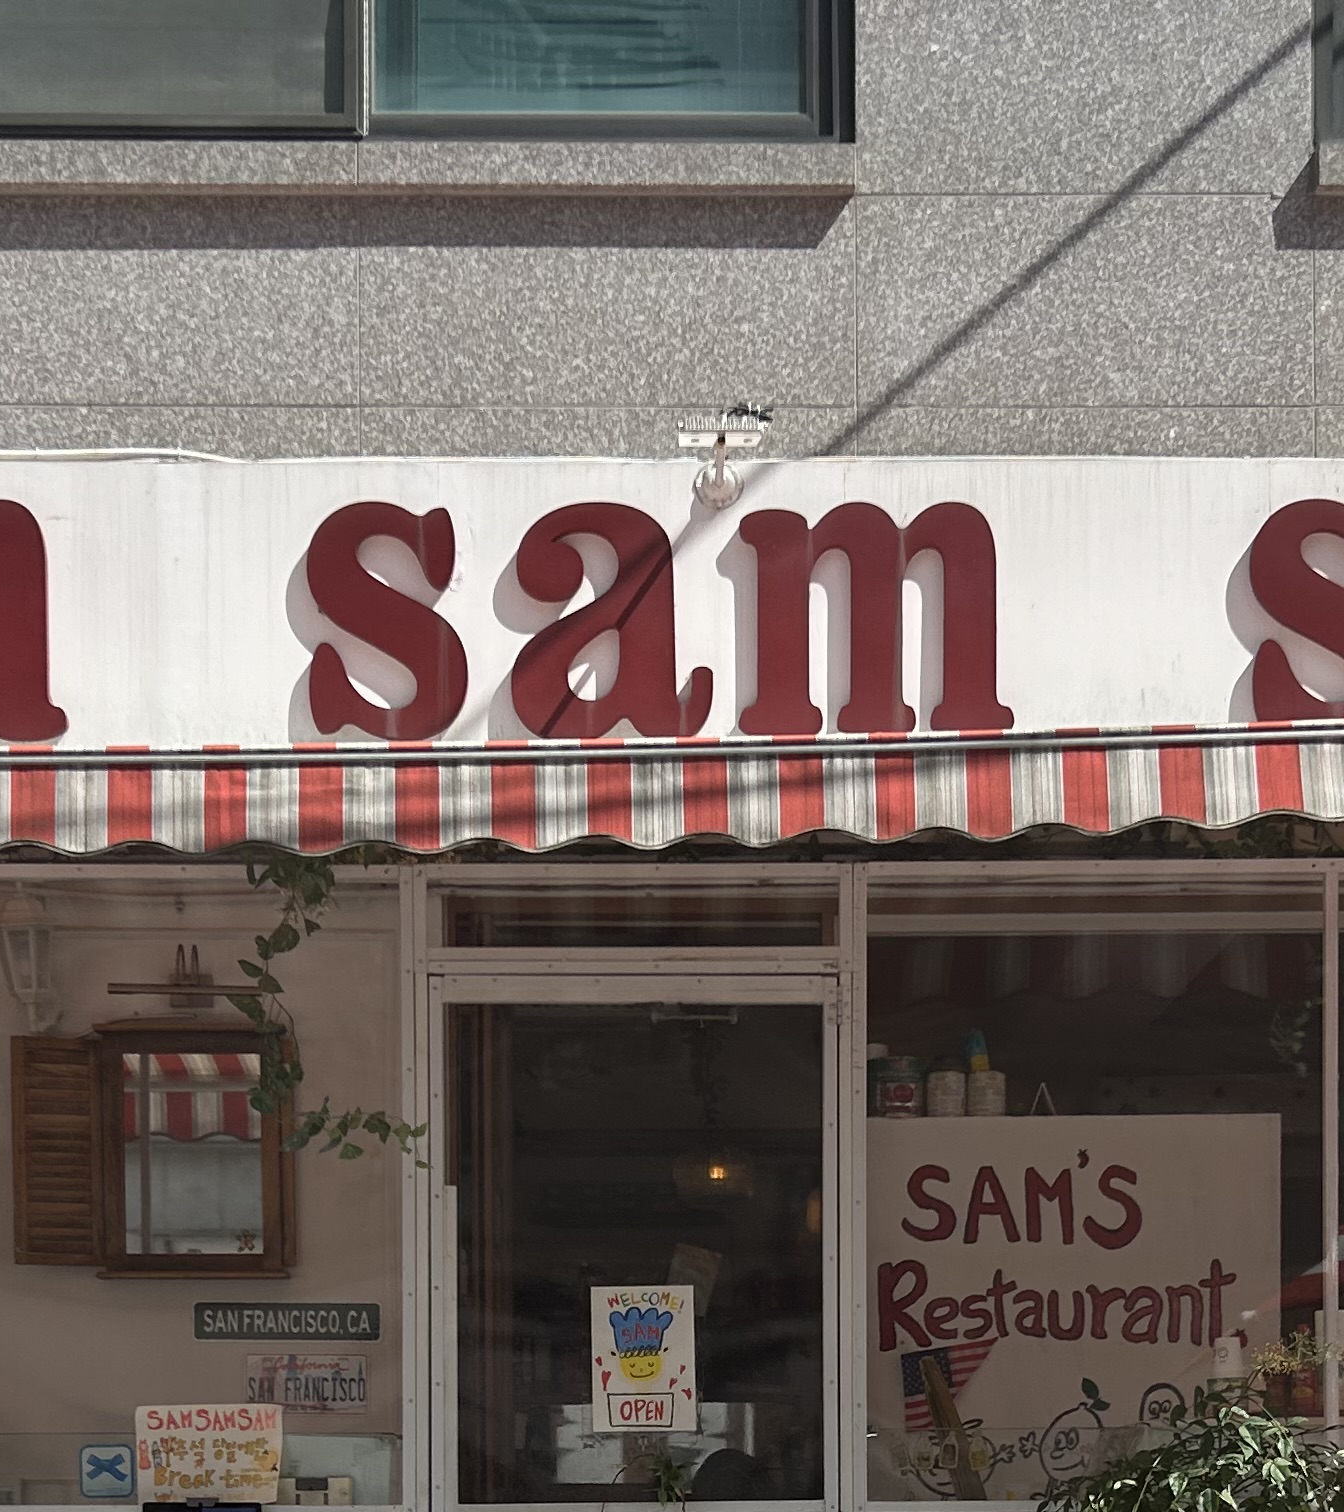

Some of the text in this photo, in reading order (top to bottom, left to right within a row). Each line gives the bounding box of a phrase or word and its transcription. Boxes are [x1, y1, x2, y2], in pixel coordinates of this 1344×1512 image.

[307, 502, 1014, 741] sam
[901, 1149, 1144, 1249] SAM'S
[607, 1291, 684, 1314] WELCOME!
[203, 1309, 371, 1335] SAN FRANCISCO, CA
[622, 1323, 660, 1344] SAM
[248, 1377, 365, 1402] SAN FRANCISCO
[620, 1399, 664, 1422] OPEN
[154, 1466, 216, 1489] Break
